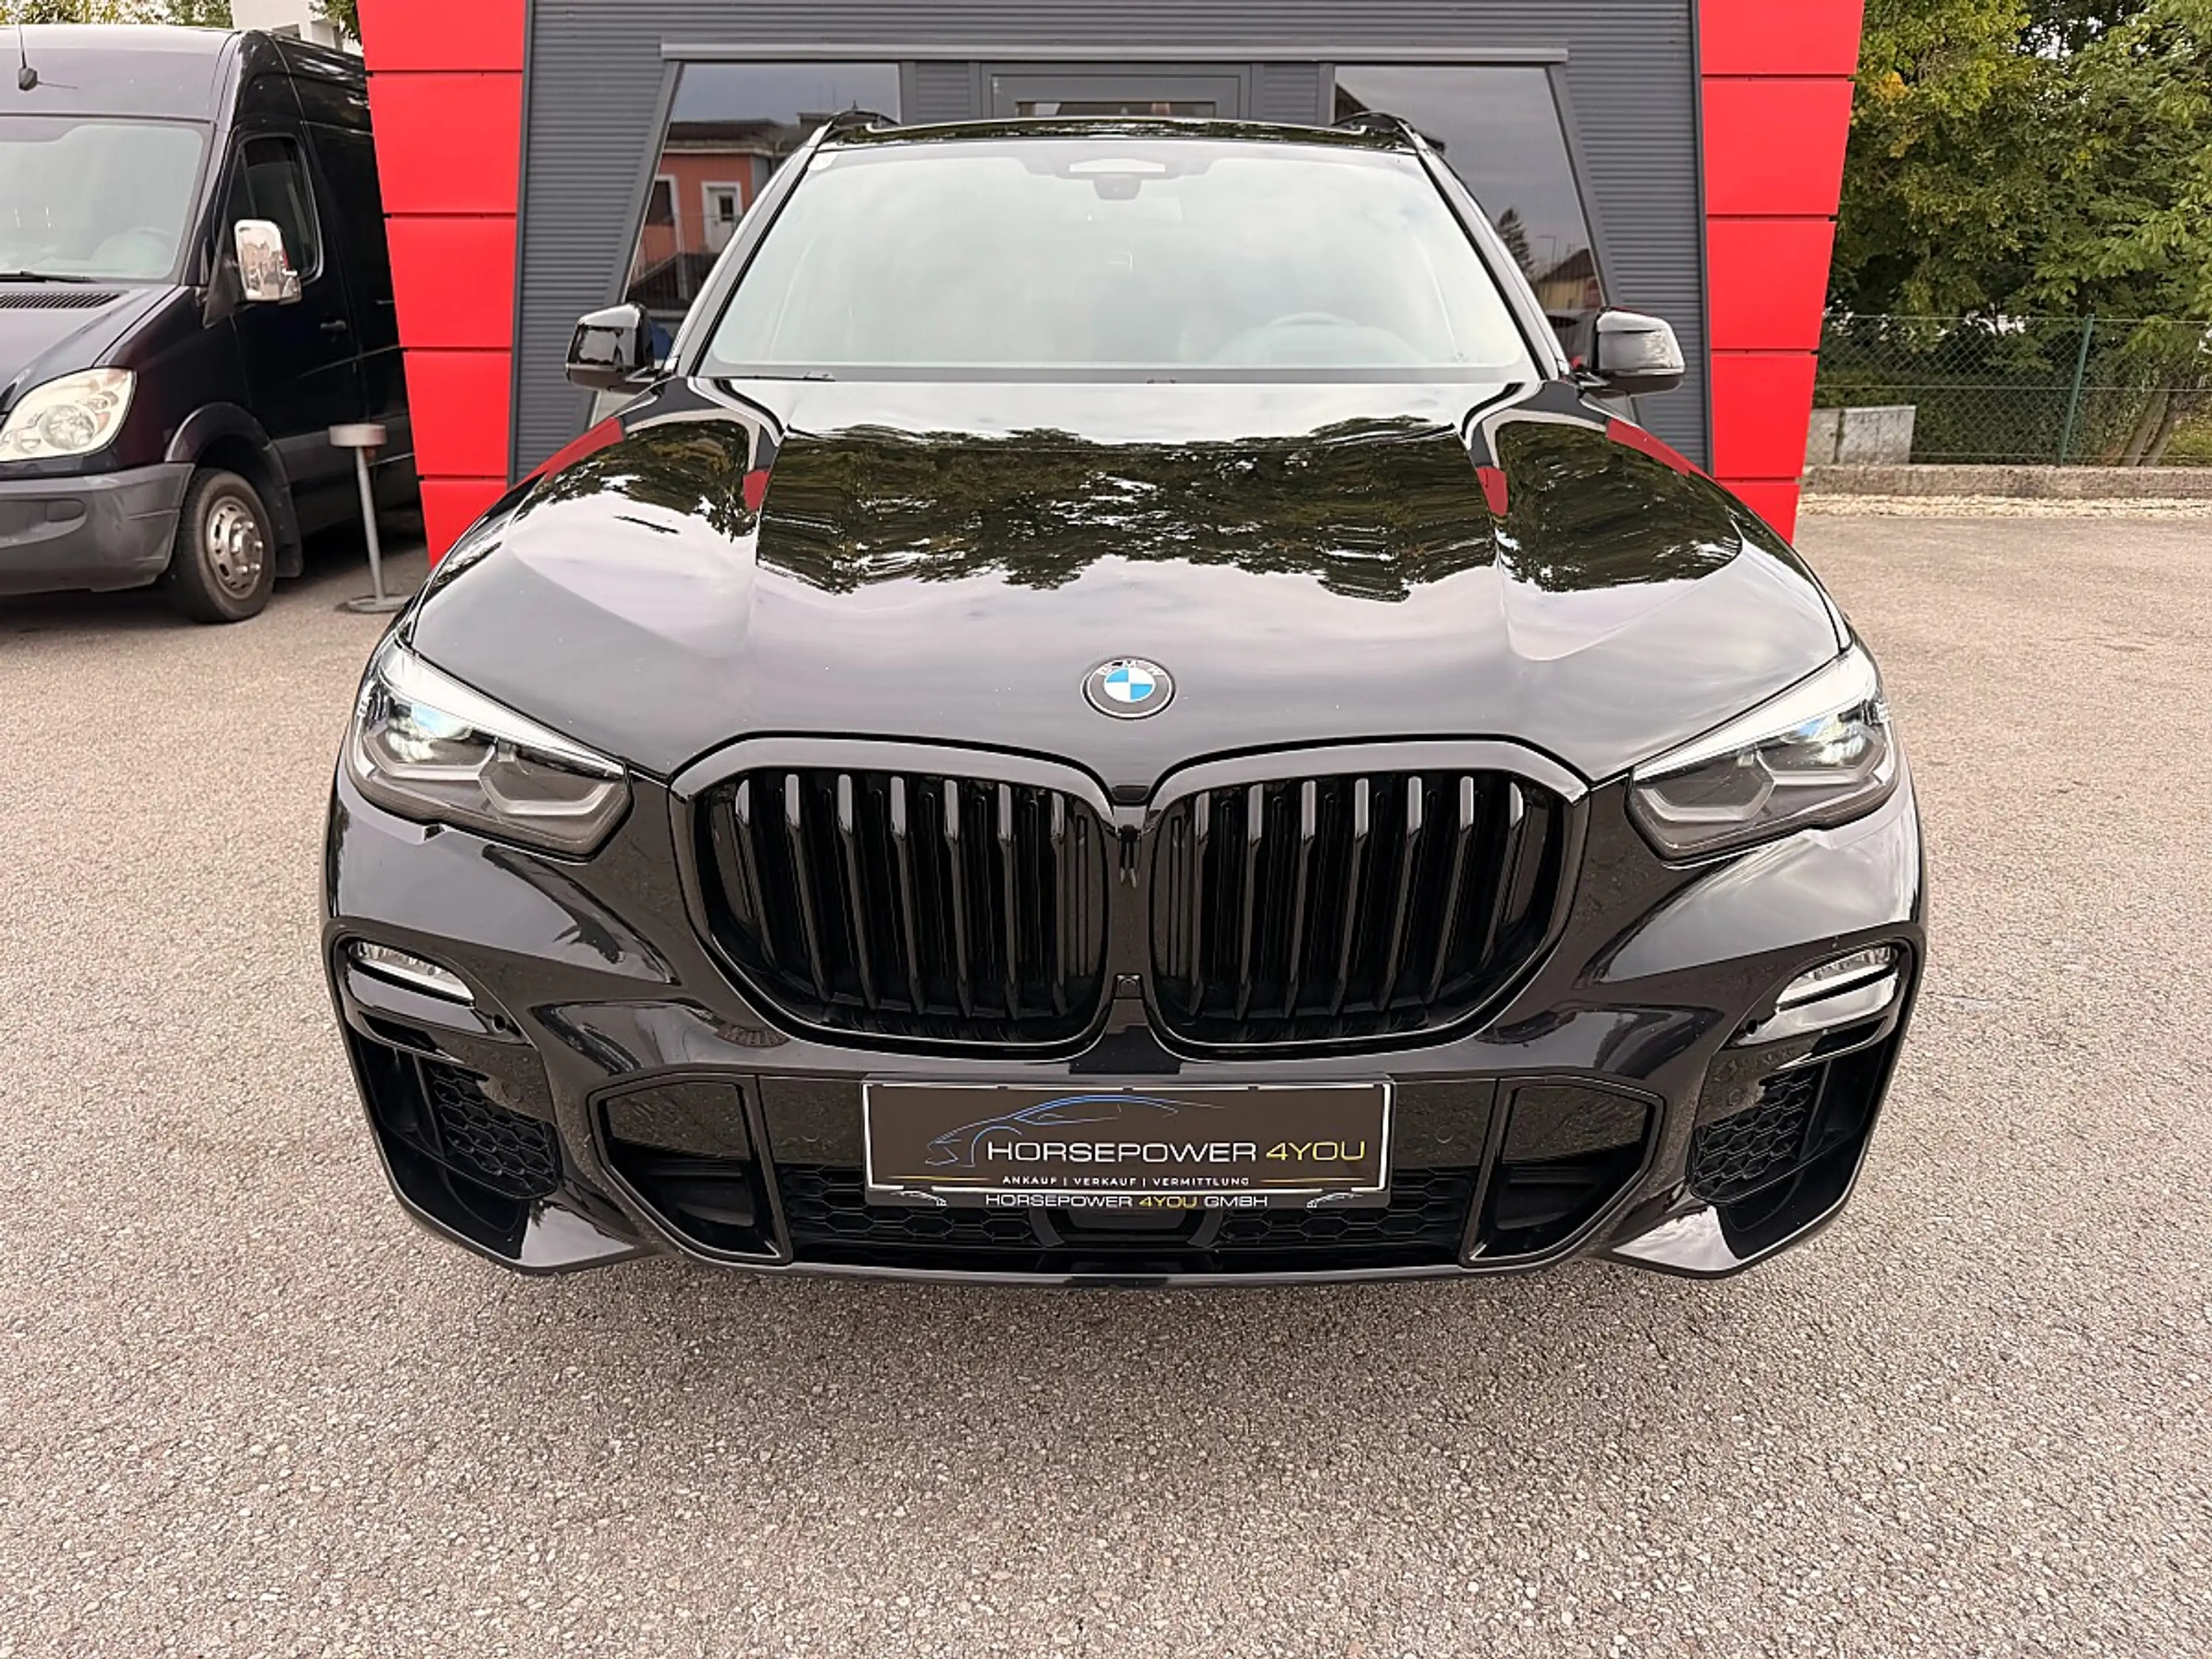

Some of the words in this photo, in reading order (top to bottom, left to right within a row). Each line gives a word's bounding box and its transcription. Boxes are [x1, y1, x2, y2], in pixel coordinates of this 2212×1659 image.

[987, 1141, 1257, 1162] HORSEPOWER
[1265, 1140, 1366, 1161] 4YOU
[1002, 1176, 1058, 1185] ANKAUF
[1073, 1176, 1137, 1186] VERKAUF
[1152, 1176, 1250, 1187] VERMITTLUNG
[985, 1194, 1134, 1207] HORSEPOWER
[1138, 1195, 1198, 1208] 4YOU
[1203, 1195, 1268, 1207] GMBH
